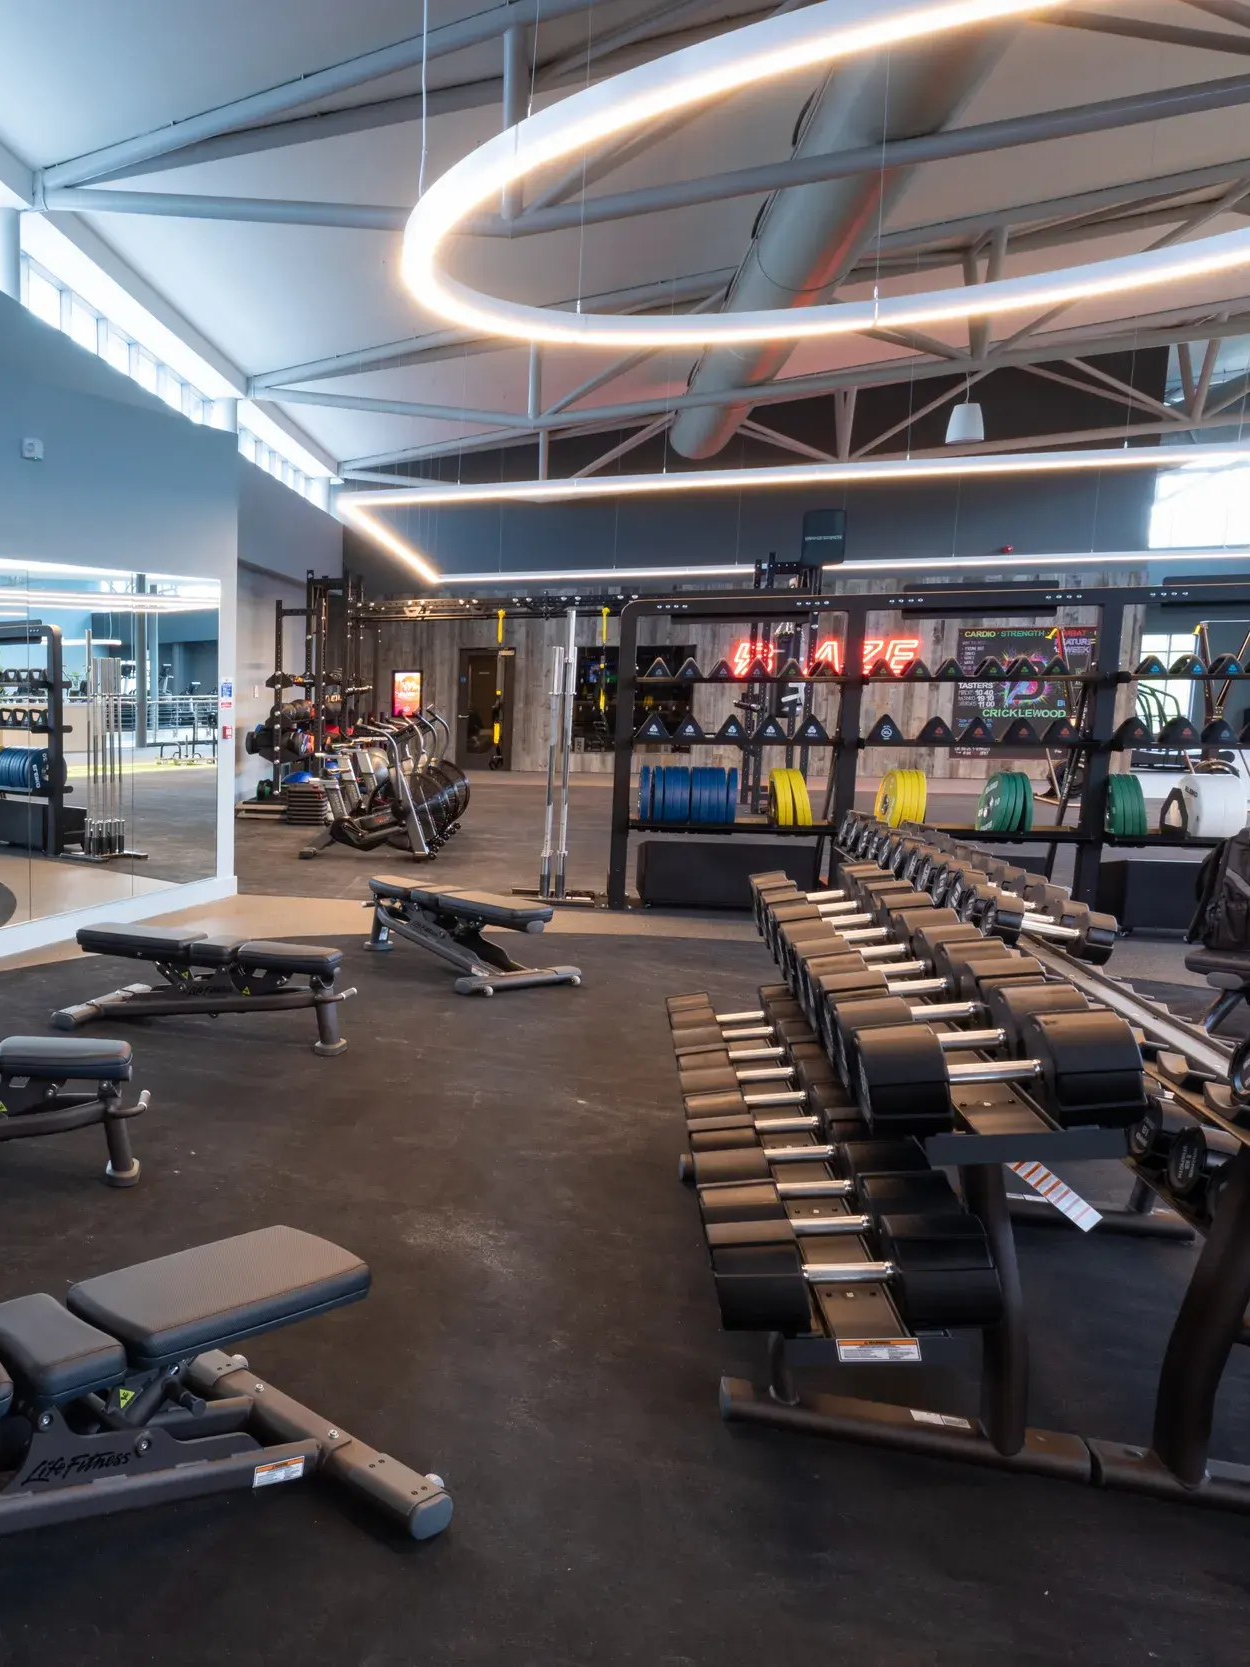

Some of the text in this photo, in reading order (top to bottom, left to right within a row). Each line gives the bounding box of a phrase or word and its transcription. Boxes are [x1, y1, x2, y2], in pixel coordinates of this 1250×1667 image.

[734, 639, 919, 676] BAZE
[982, 709, 1067, 718] CRICKLEWOOD
[20, 1451, 131, 1486] Life Fitness
